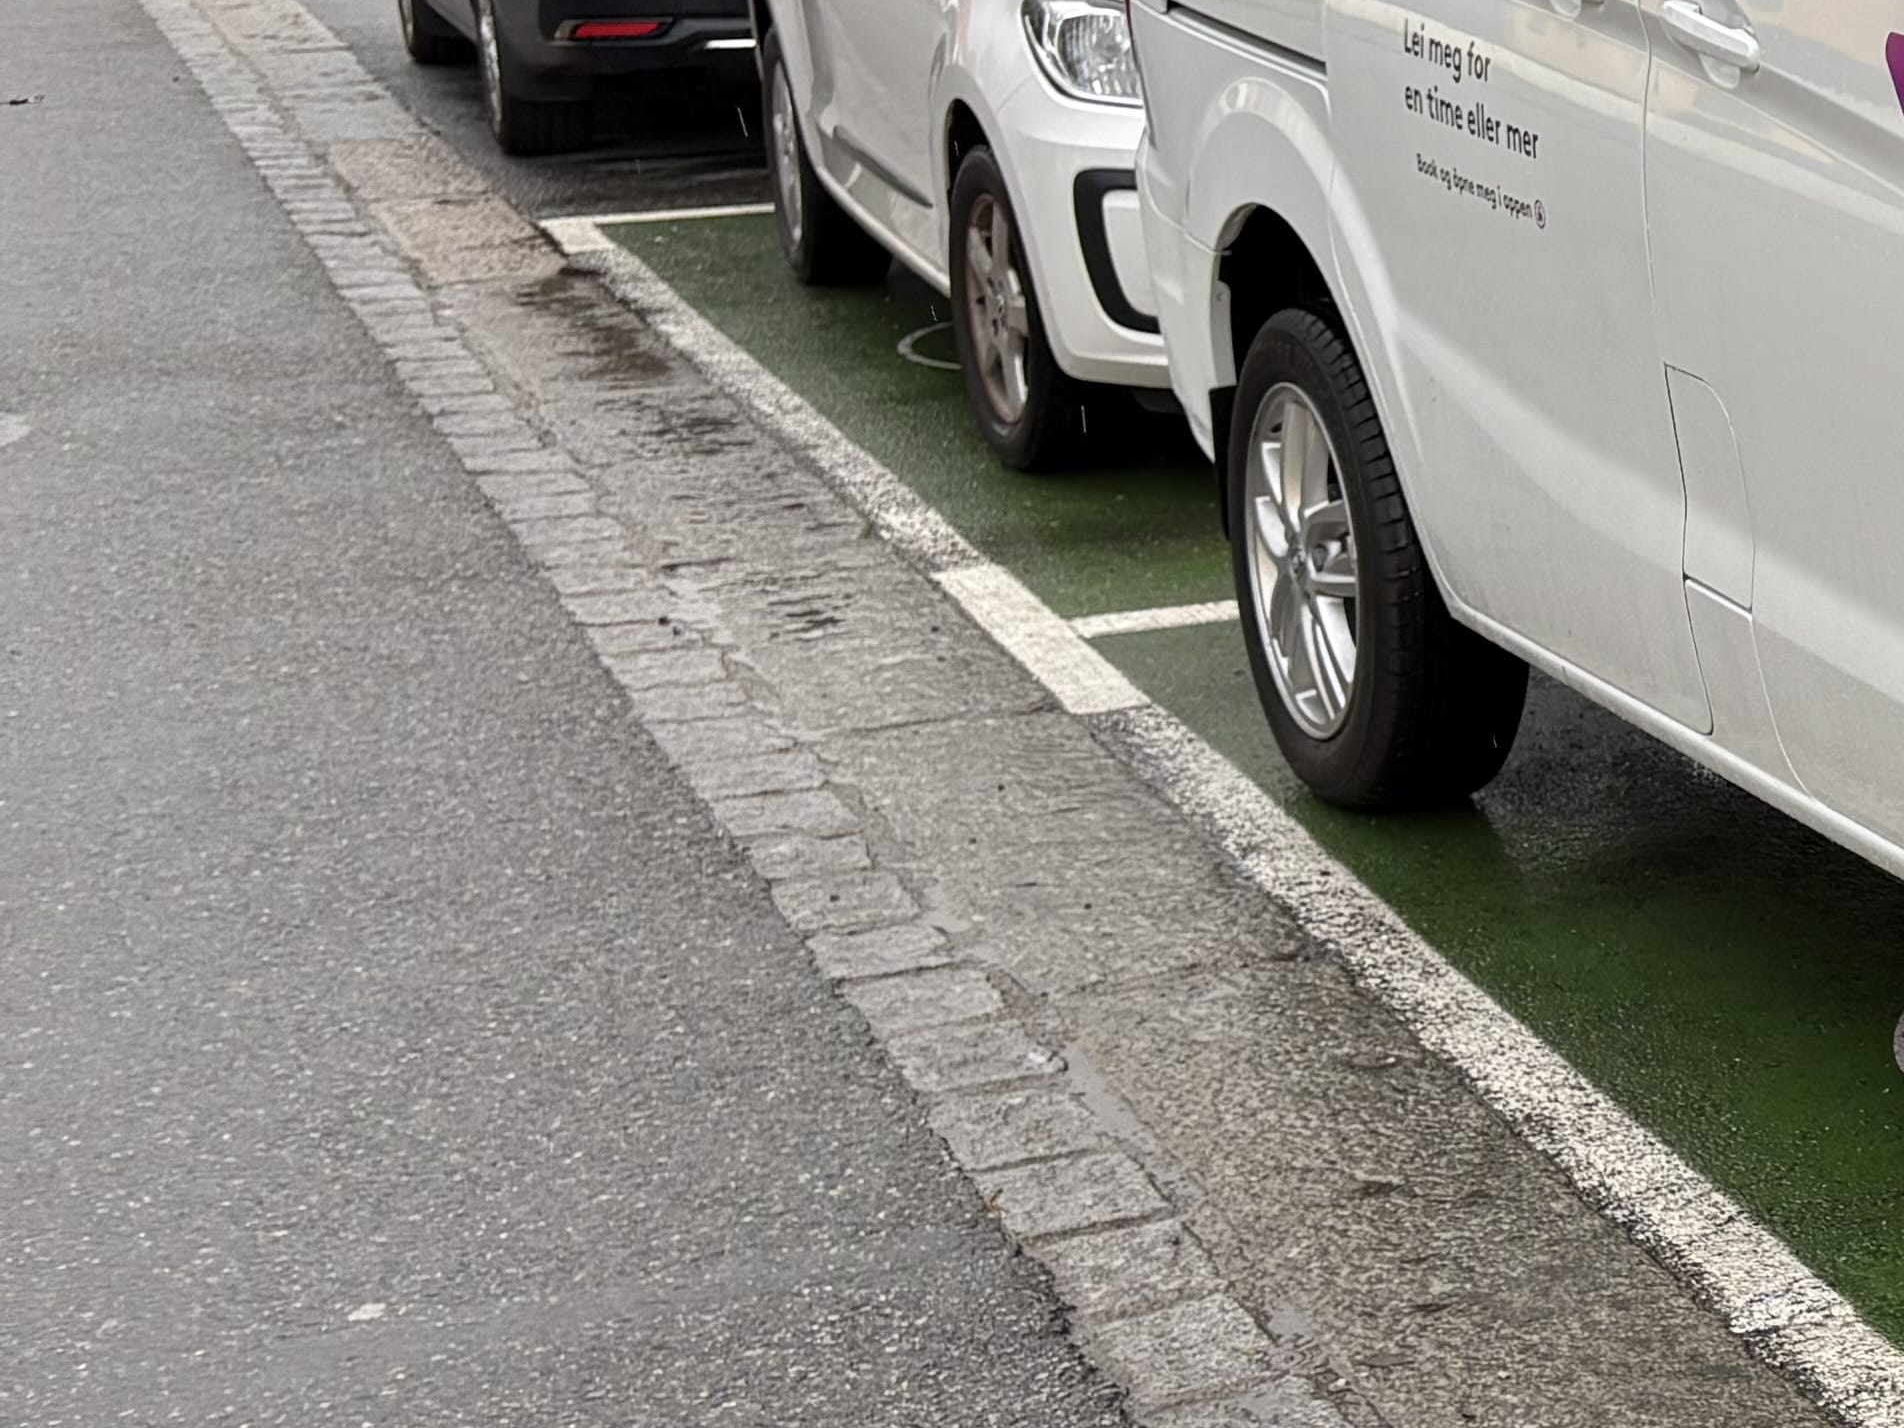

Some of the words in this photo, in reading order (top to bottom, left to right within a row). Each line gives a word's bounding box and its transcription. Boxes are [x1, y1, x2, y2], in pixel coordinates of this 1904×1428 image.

[1404, 18, 1425, 59] Lei
[1428, 36, 1462, 83] meg
[1467, 41, 1492, 82] for
[1404, 85, 1423, 115] en
[1427, 85, 1463, 130] time
[1467, 102, 1501, 145] eller
[1506, 123, 1539, 159] mer
